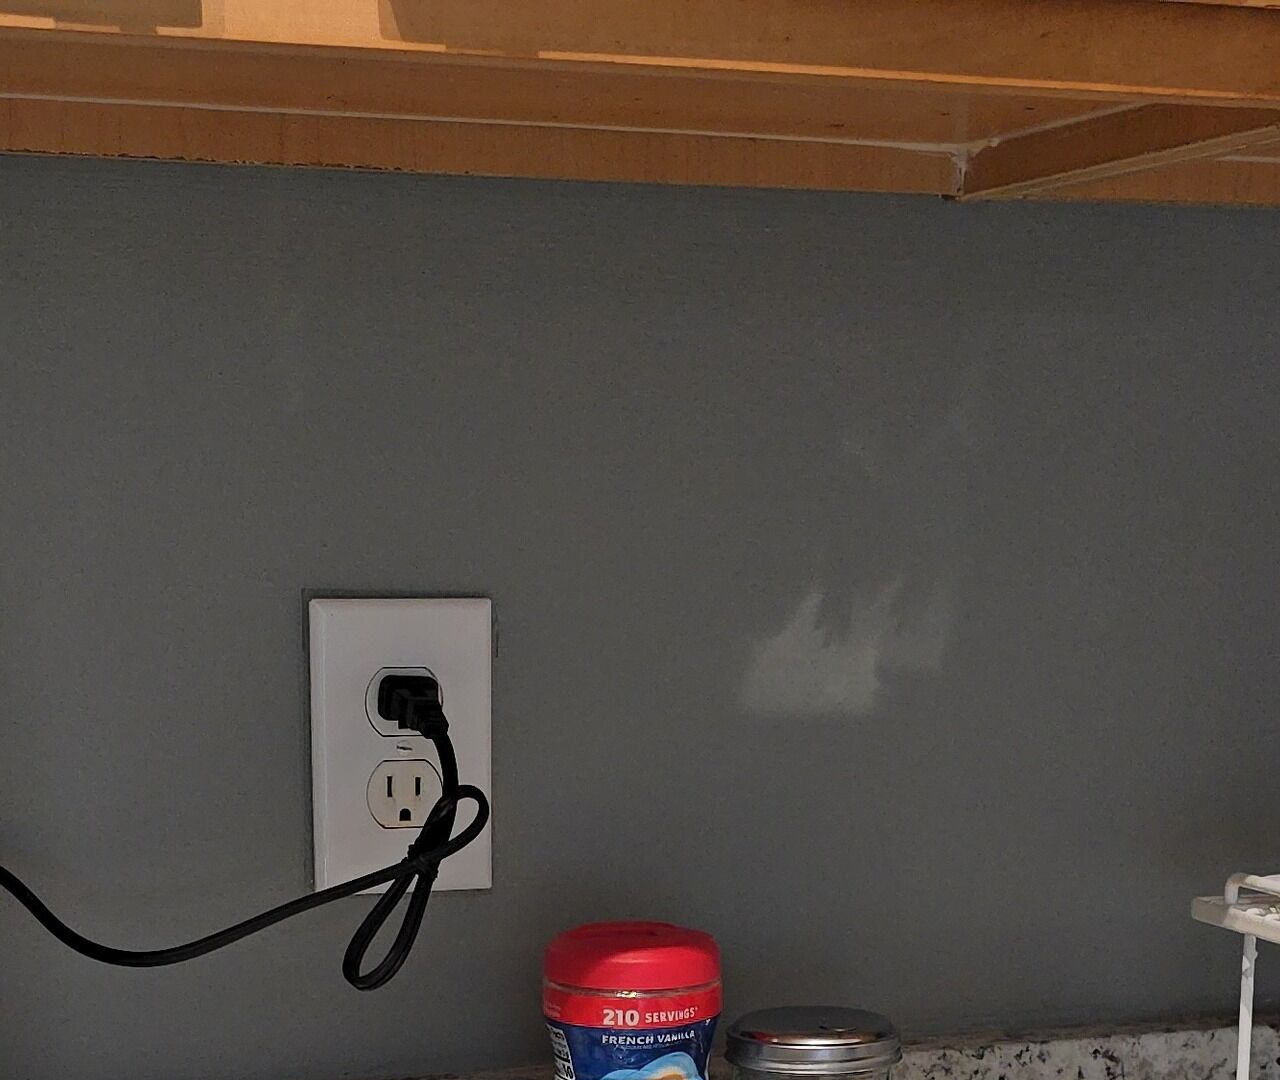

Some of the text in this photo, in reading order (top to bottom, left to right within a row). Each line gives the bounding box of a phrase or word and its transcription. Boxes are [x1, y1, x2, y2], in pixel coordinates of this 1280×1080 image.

[602, 1008, 640, 1026] 210
[601, 1029, 696, 1046] FRENCH VANILLA
